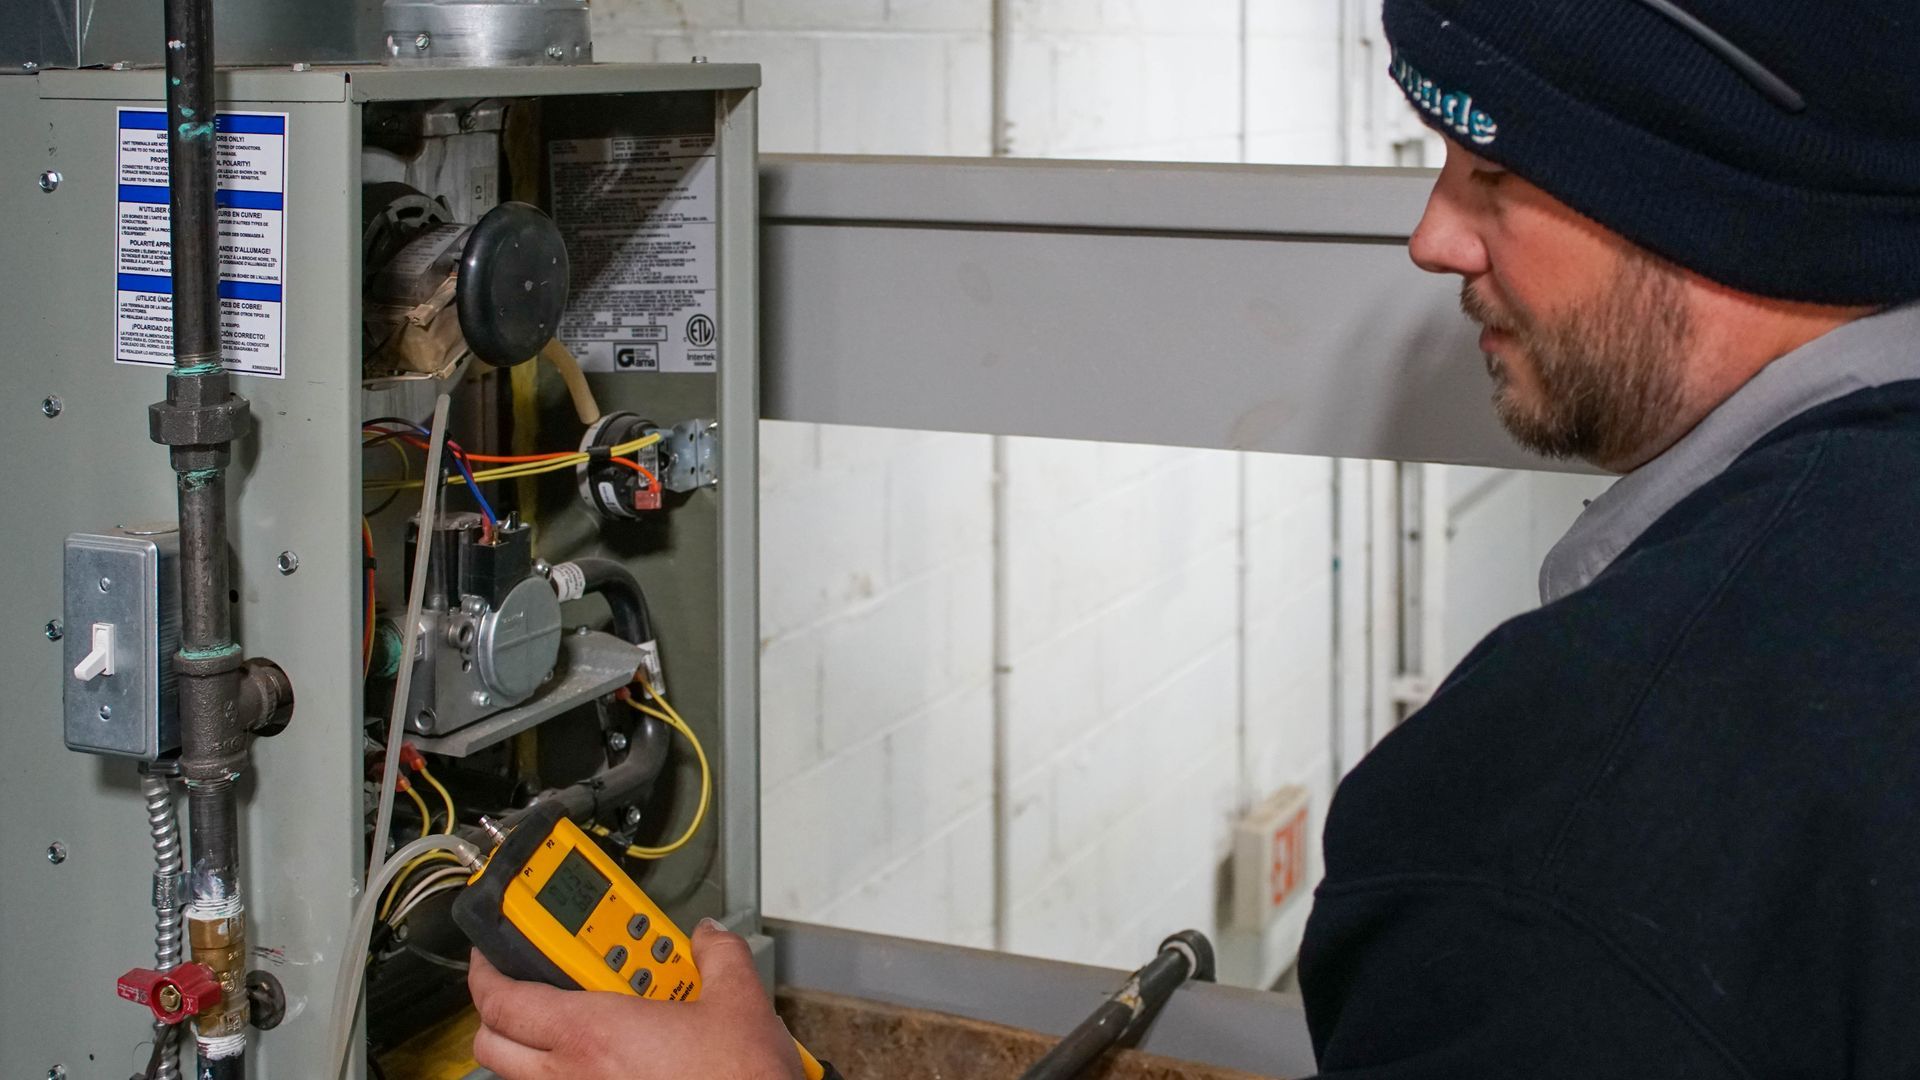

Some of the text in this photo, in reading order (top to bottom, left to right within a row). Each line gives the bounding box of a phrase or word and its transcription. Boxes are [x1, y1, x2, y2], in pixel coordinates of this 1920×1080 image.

[524, 840, 555, 877] P1 P2
[638, 972, 649, 987] HOLD
[673, 980, 685, 995] Port
